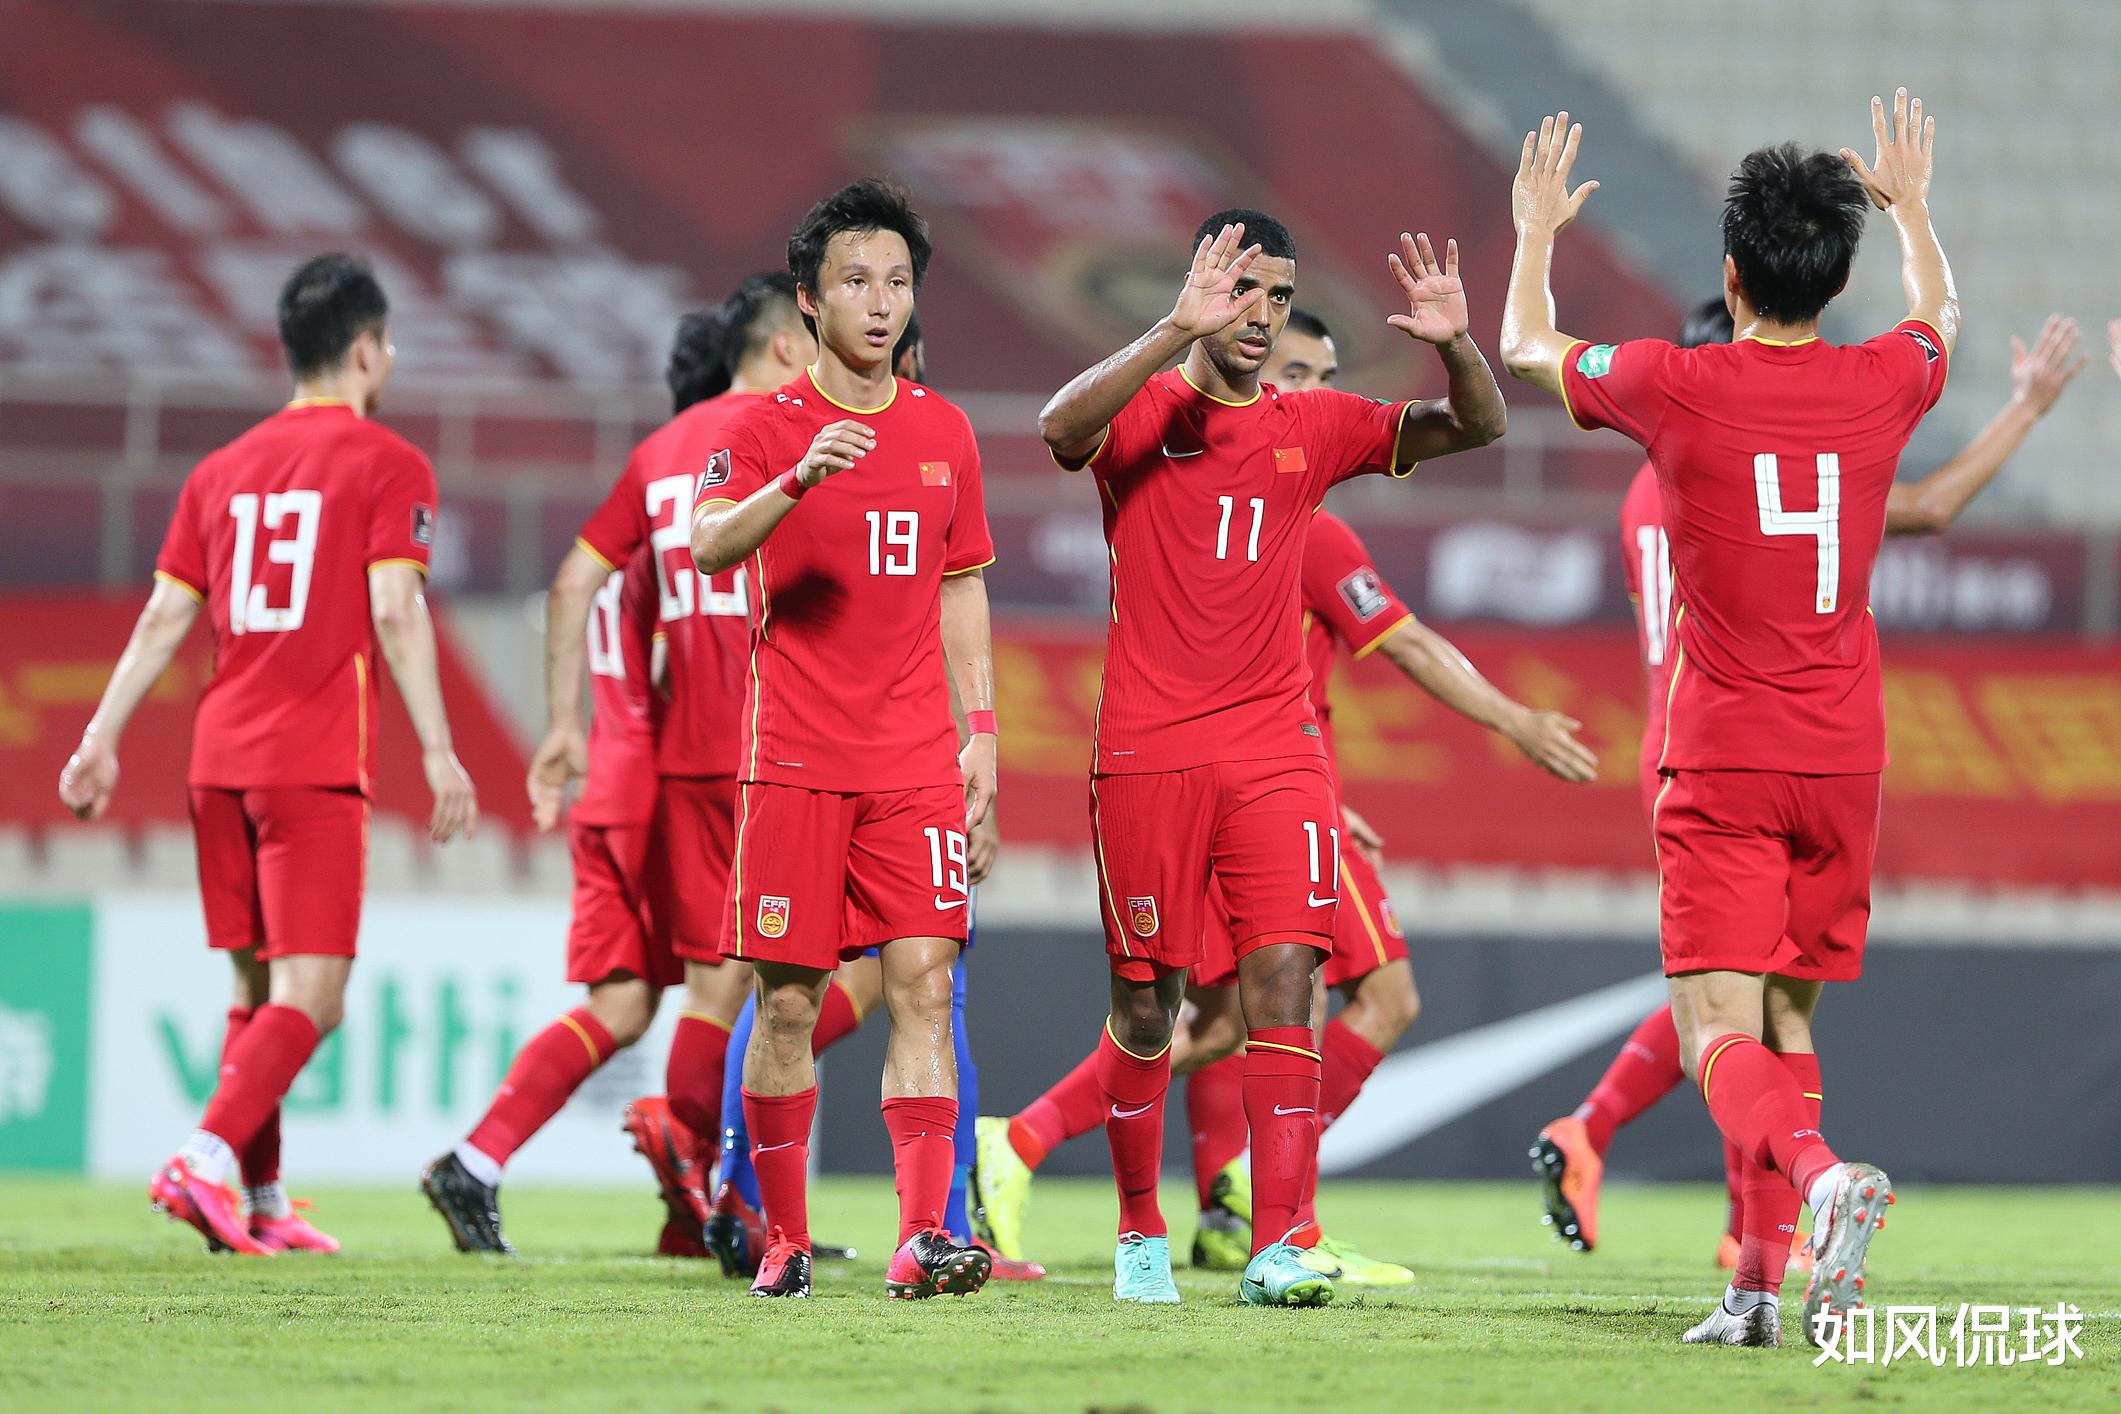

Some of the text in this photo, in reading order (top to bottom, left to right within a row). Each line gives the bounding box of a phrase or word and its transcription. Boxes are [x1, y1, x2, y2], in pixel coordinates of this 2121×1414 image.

[865, 510, 919, 575] 19
[1216, 495, 1264, 561] 11
[1754, 453, 1841, 614] 4
[229, 490, 323, 635] 13
[924, 827, 967, 895] 19
[1303, 821, 1338, 891] 11
[763, 899, 786, 908] CFA
[1130, 900, 1151, 908] CFA
